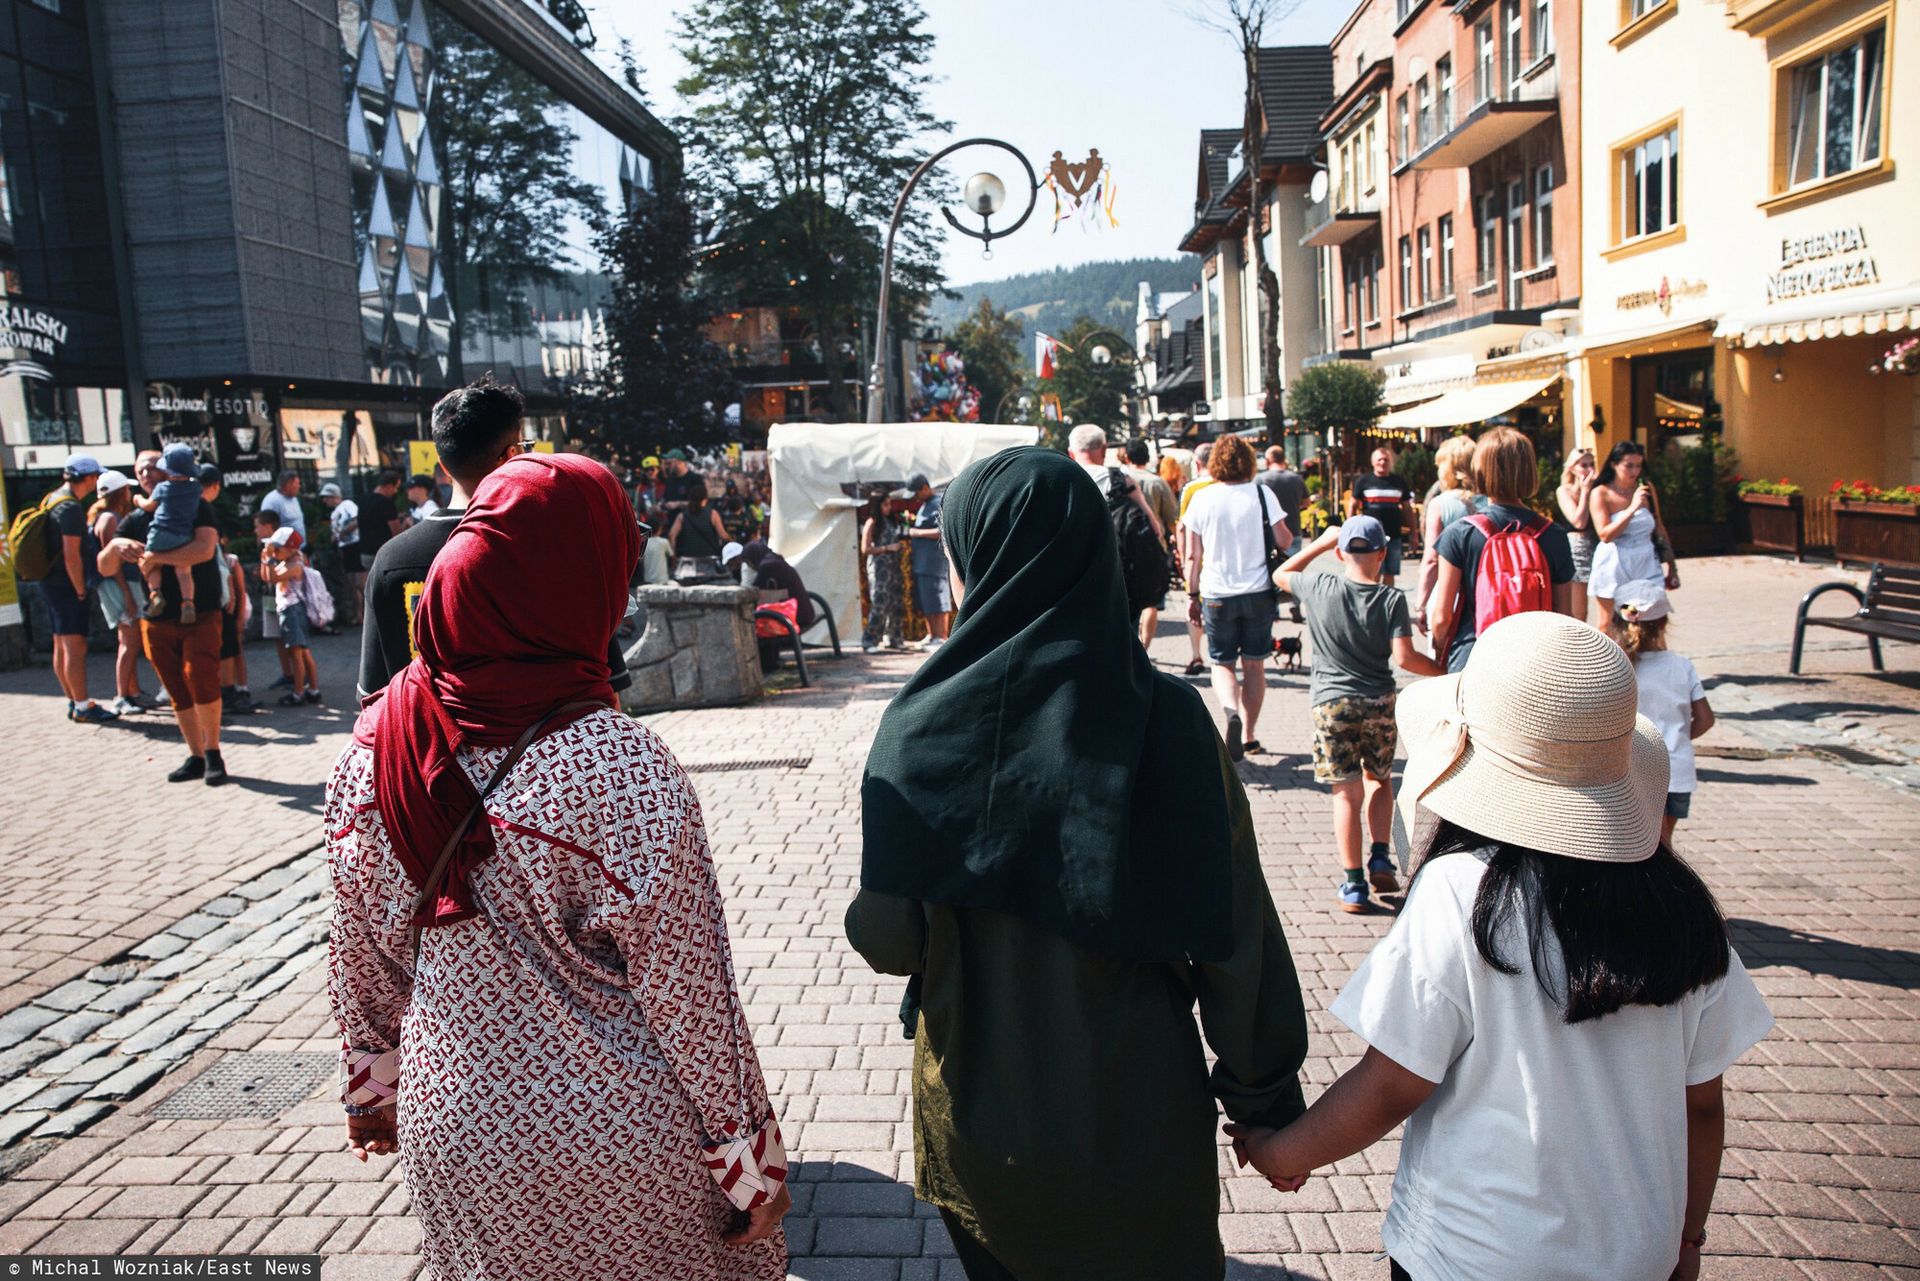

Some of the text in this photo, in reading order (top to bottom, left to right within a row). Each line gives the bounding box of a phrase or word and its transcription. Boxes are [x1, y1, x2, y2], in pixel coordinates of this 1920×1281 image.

[1780, 224, 1867, 270] LEGENDA
[149, 397, 208, 411] SALOMON
[214, 398, 269, 419] ESOTIQ
[222, 468, 272, 487] patagonia
